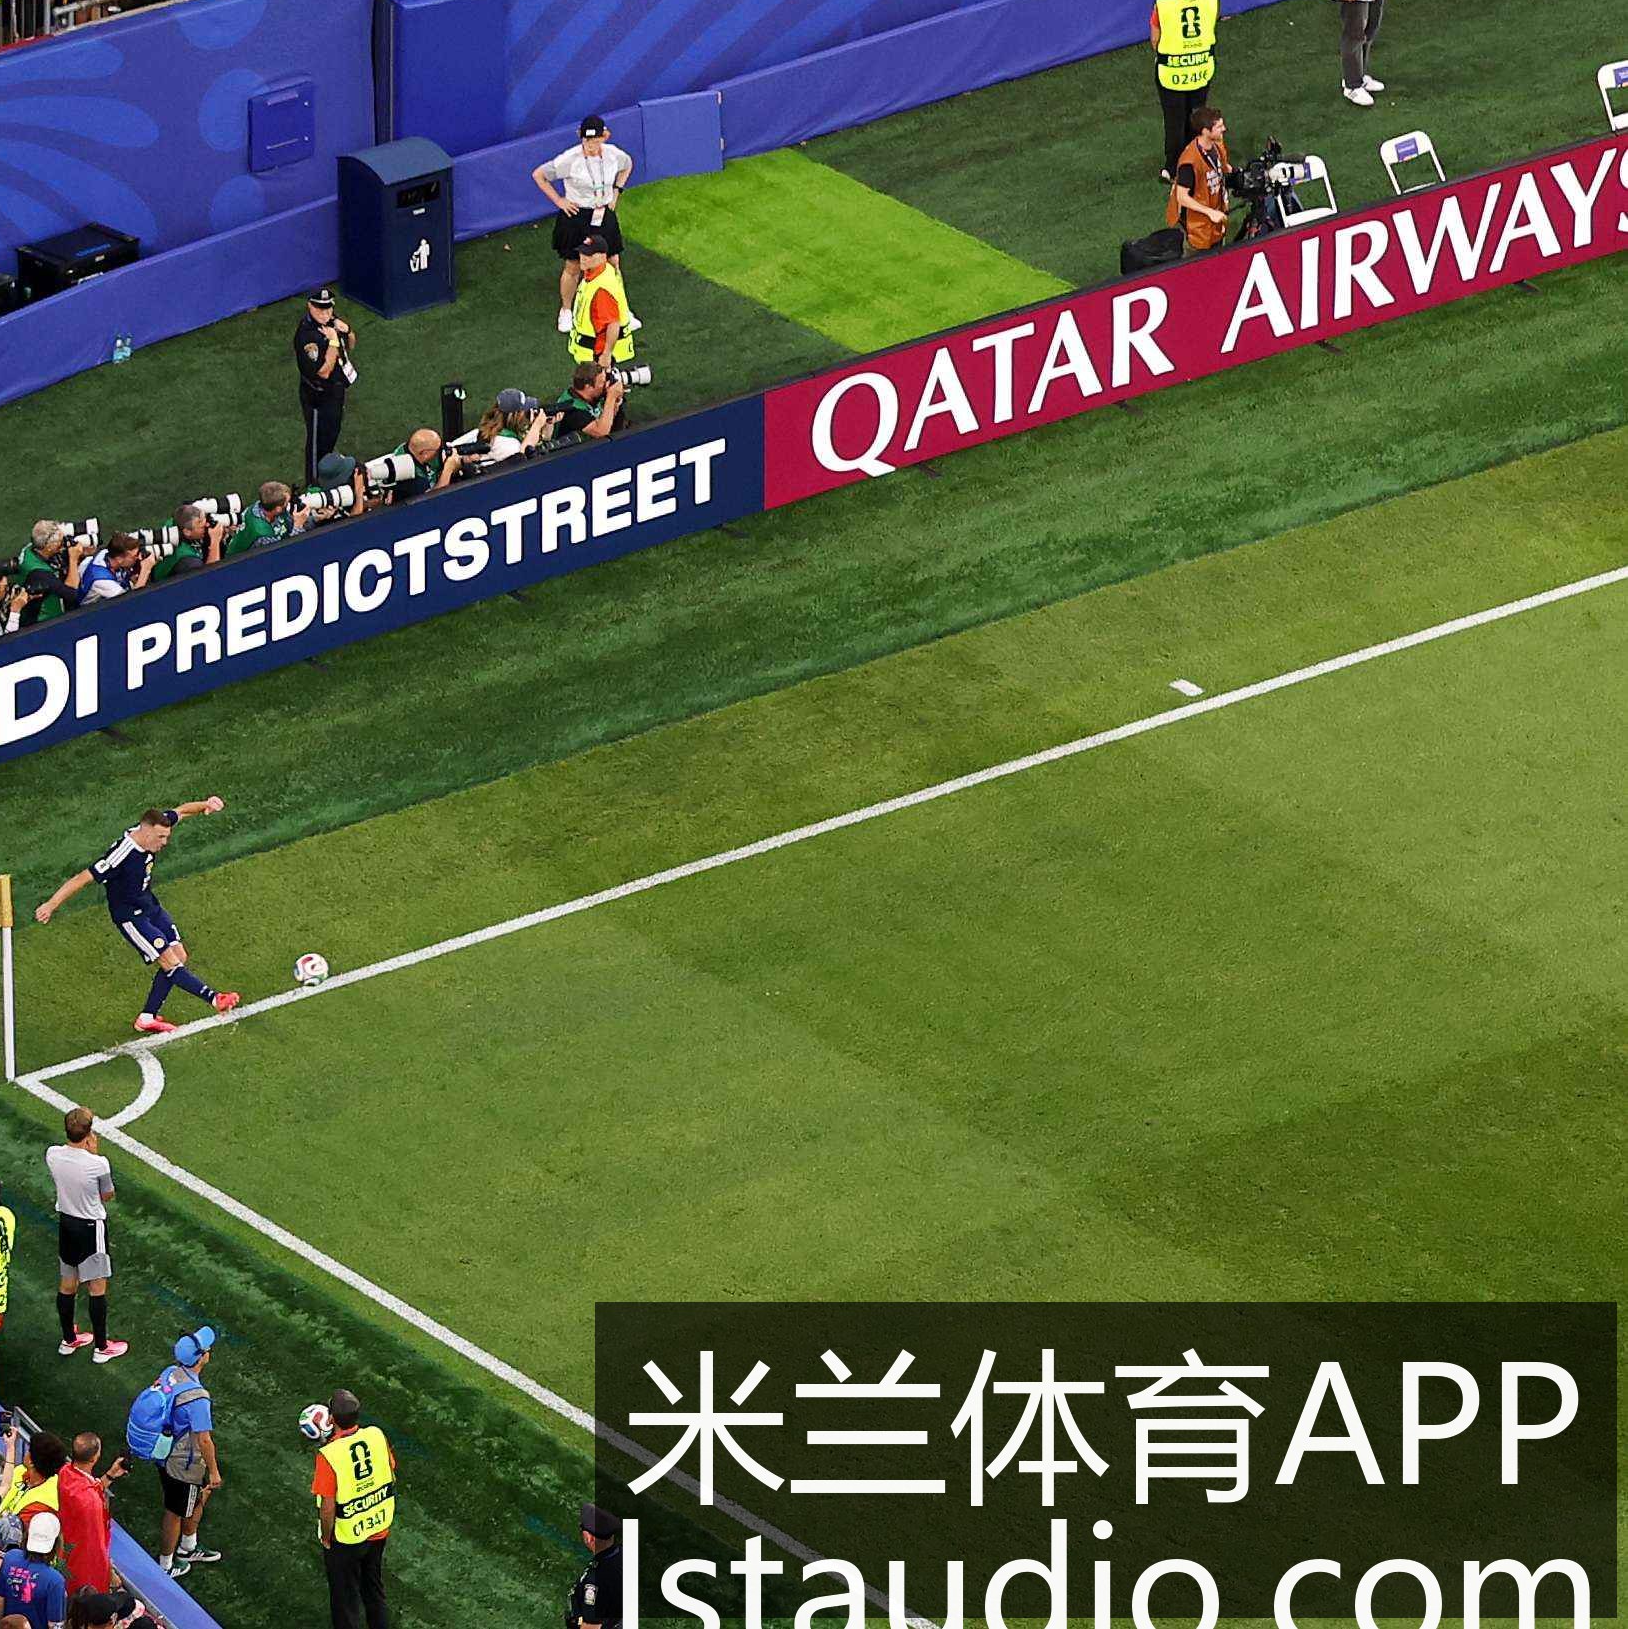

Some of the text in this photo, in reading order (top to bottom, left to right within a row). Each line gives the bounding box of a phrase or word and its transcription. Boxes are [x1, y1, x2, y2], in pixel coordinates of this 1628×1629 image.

[811, 143, 1628, 477] QATAR AIRWAY
[127, 438, 726, 690] PREDICTSTREET
[343, 1485, 390, 1518] SECURITY
